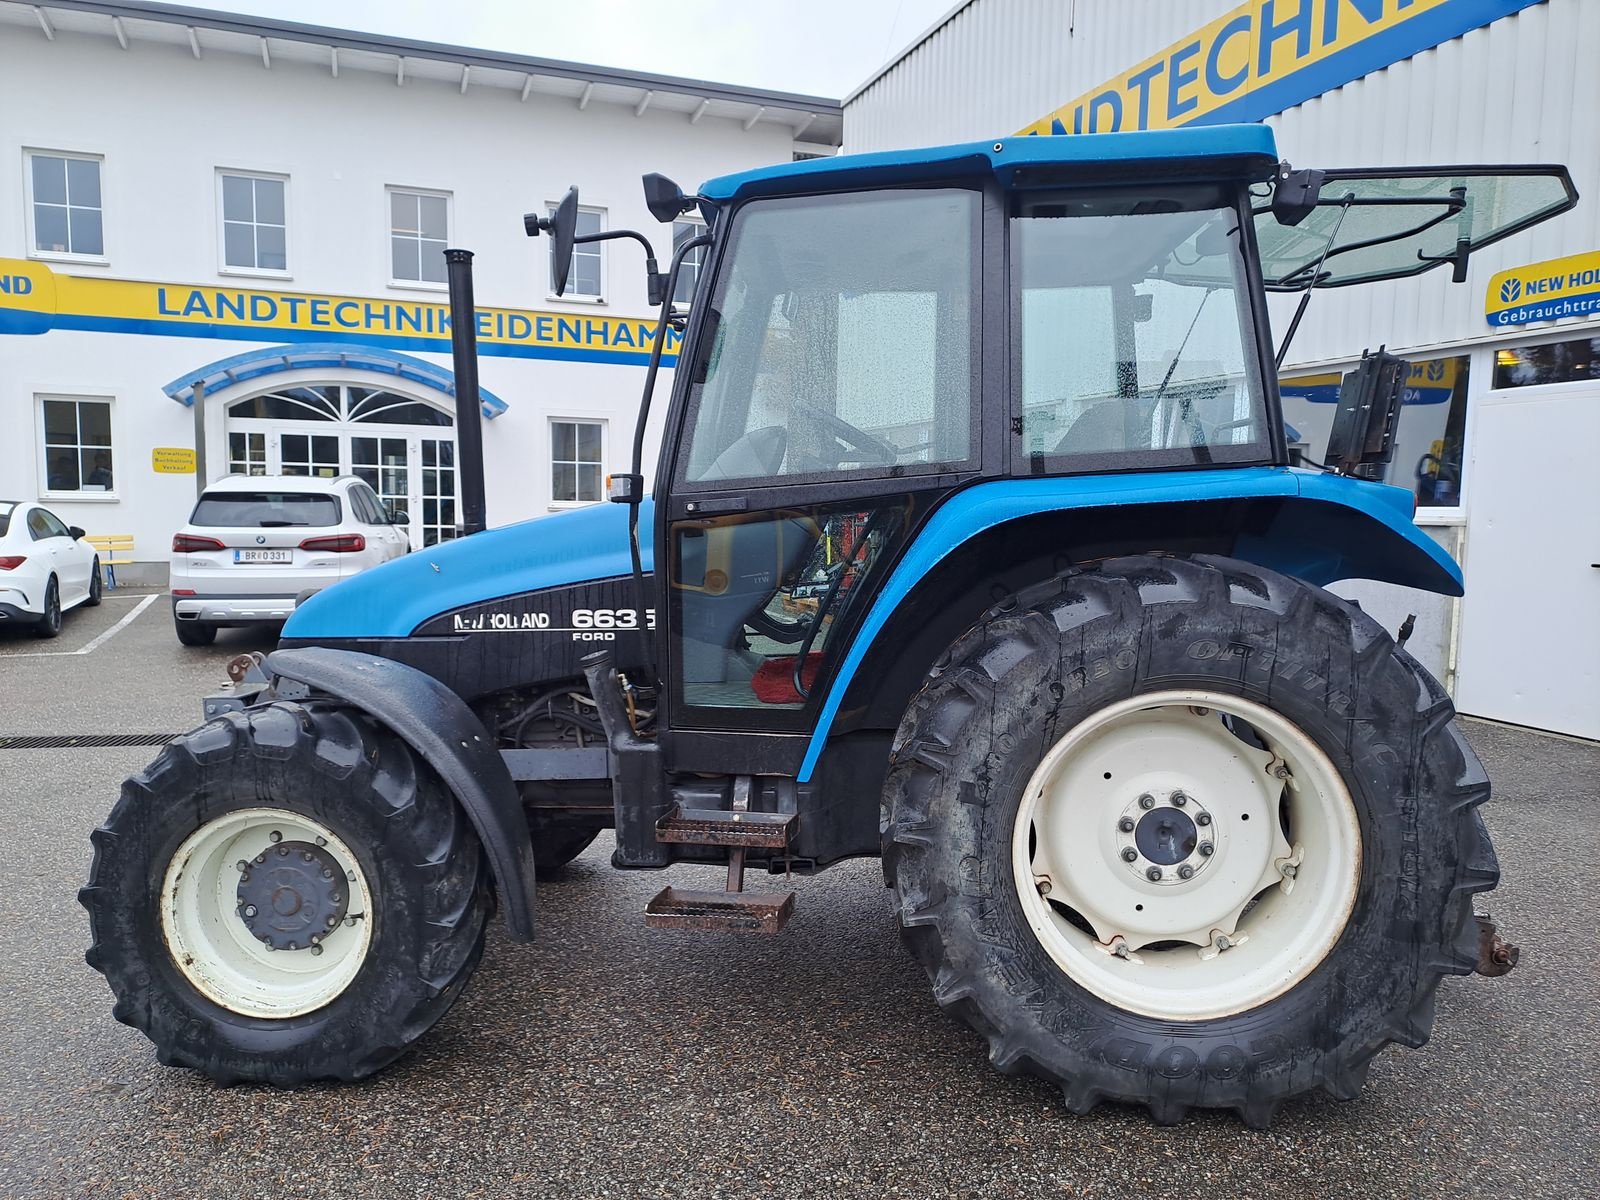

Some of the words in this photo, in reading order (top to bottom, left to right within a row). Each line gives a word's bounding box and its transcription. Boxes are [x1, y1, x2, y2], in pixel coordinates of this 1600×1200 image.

[1525, 275, 1564, 295] NEW
[245, 551, 256, 560] BR
[572, 632, 615, 641] FORD
